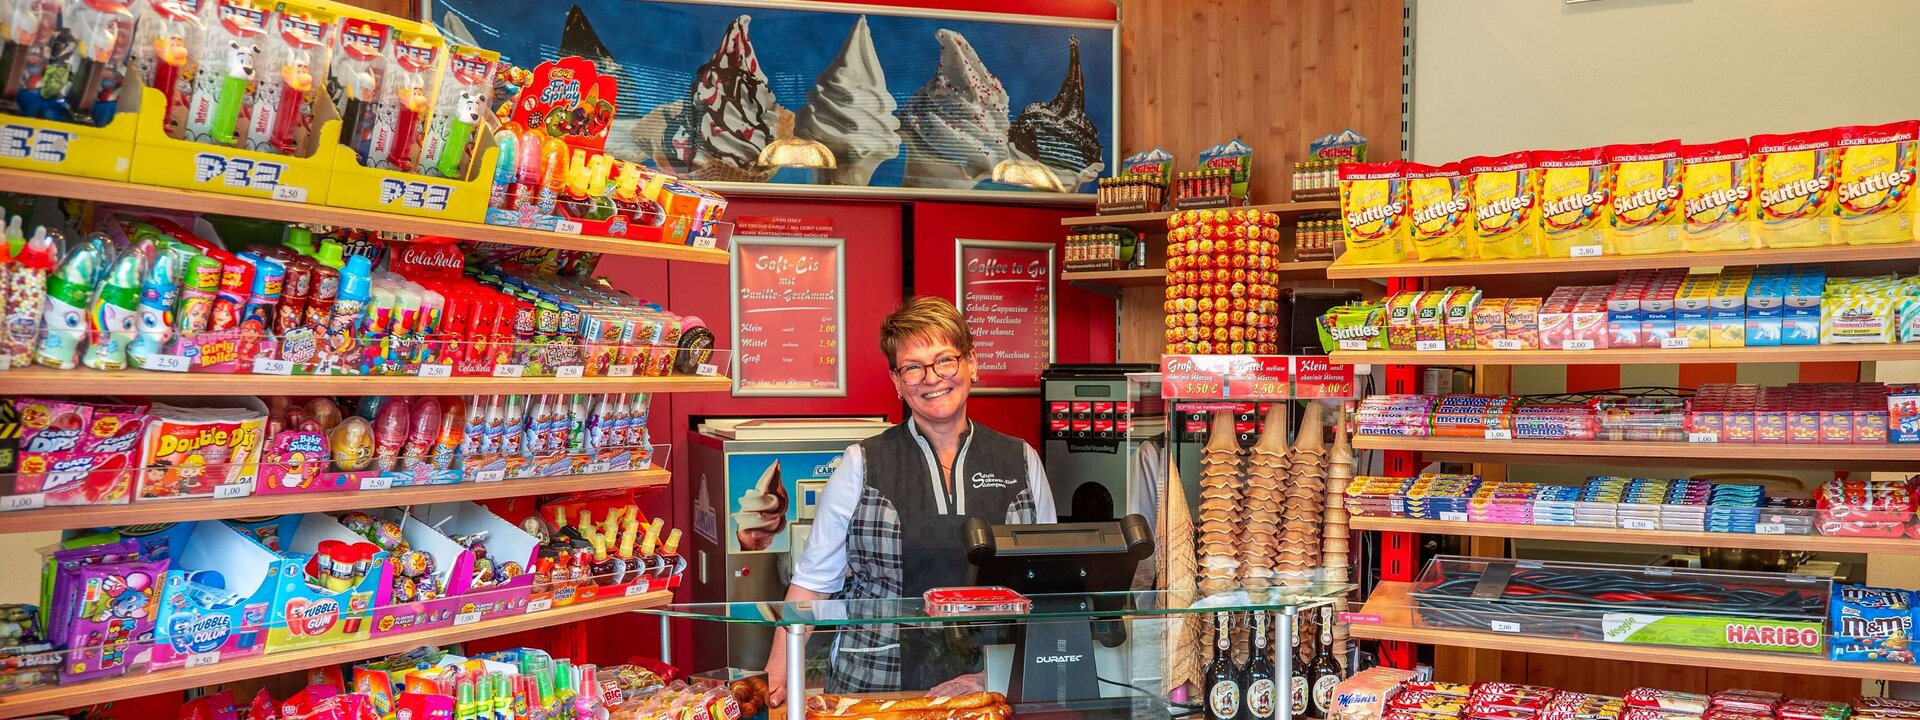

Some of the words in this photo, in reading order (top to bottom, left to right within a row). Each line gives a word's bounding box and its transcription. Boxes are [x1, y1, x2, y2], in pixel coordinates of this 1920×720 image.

[541, 87, 580, 108] Spray
[195, 152, 281, 191] PEZ
[1759, 175, 1830, 210] Skittles
[1839, 169, 1910, 205] Skittles
[379, 177, 449, 211] PEZ
[1614, 184, 1678, 216] Skittles
[1543, 190, 1604, 219] Skittles
[1347, 200, 1402, 229] Skittles
[1412, 197, 1466, 225] Skittles
[1579, 247, 1594, 256] 2,80
[967, 258, 1007, 277] Coffee
[1012, 262, 1023, 274] to
[1027, 260, 1046, 278] Go
[779, 275, 797, 286] mit
[741, 288, 835, 302] Vanille-Geschmack
[966, 292, 1003, 302] Cappuccino
[966, 303, 989, 313] Schoko
[991, 305, 1028, 314] Cappuccino
[966, 315, 985, 324] Latte
[987, 315, 1022, 325] Macchiato
[741, 323, 762, 333] Klein
[990, 328, 1015, 336] schwarz
[1331, 323, 1379, 345] Skittles
[201, 341, 236, 356] Girly
[741, 338, 768, 348] Mittel
[1345, 341, 1359, 349] 1,50
[1422, 341, 1437, 350] 2,80
[1499, 340, 1513, 348] 2,00
[1571, 341, 1586, 349] 2,00
[1667, 339, 1683, 348] 2,50
[201, 351, 238, 367] Roller
[741, 353, 761, 365] Groß
[995, 351, 1030, 360] Macchiato
[158, 357, 179, 369] 2,50
[265, 363, 283, 372] 2,50
[1167, 359, 1192, 373] Groß
[1300, 360, 1327, 372] Klein
[428, 367, 443, 376] 2,50
[500, 367, 514, 375] 2,50
[564, 367, 578, 375] 2,50
[614, 367, 627, 375] 2,50
[1185, 383, 1209, 395] 3,50
[1211, 383, 1218, 394] €
[1253, 383, 1275, 395] 2,50
[1277, 384, 1284, 394] €
[1319, 383, 1341, 395] 2,00
[1342, 383, 1349, 394] €
[1436, 414, 1481, 425] mentos
[39, 429, 82, 438] CRAZY
[1361, 427, 1404, 437] mentos
[1489, 431, 1504, 439] 1,00
[1516, 427, 1565, 437] mentos
[28, 436, 80, 454] DIPS
[156, 427, 228, 458] Double
[229, 428, 258, 452] Dip
[298, 434, 322, 446] Baby
[289, 442, 322, 454] Sucker
[1071, 444, 1092, 452] Bianchi
[1092, 445, 1115, 453] Vending
[54, 456, 95, 471] CRAZY
[41, 465, 92, 492] DIPS
[223, 487, 240, 496] 1,00
[1763, 524, 1779, 532] 1,50
[304, 601, 338, 618] TUBBLE
[192, 615, 229, 633] TUBBLE
[307, 615, 331, 630] GUM
[1497, 623, 1512, 631] 2,00
[1608, 616, 1636, 641] Veggie
[1843, 615, 1912, 637] m&m's
[194, 628, 227, 644] COLOR
[1726, 623, 1819, 648] HARIBO
[1036, 654, 1083, 664] DURATEC
[604, 688, 622, 702] BIG
[1338, 692, 1378, 708] Manner
[724, 701, 738, 716] BIG
